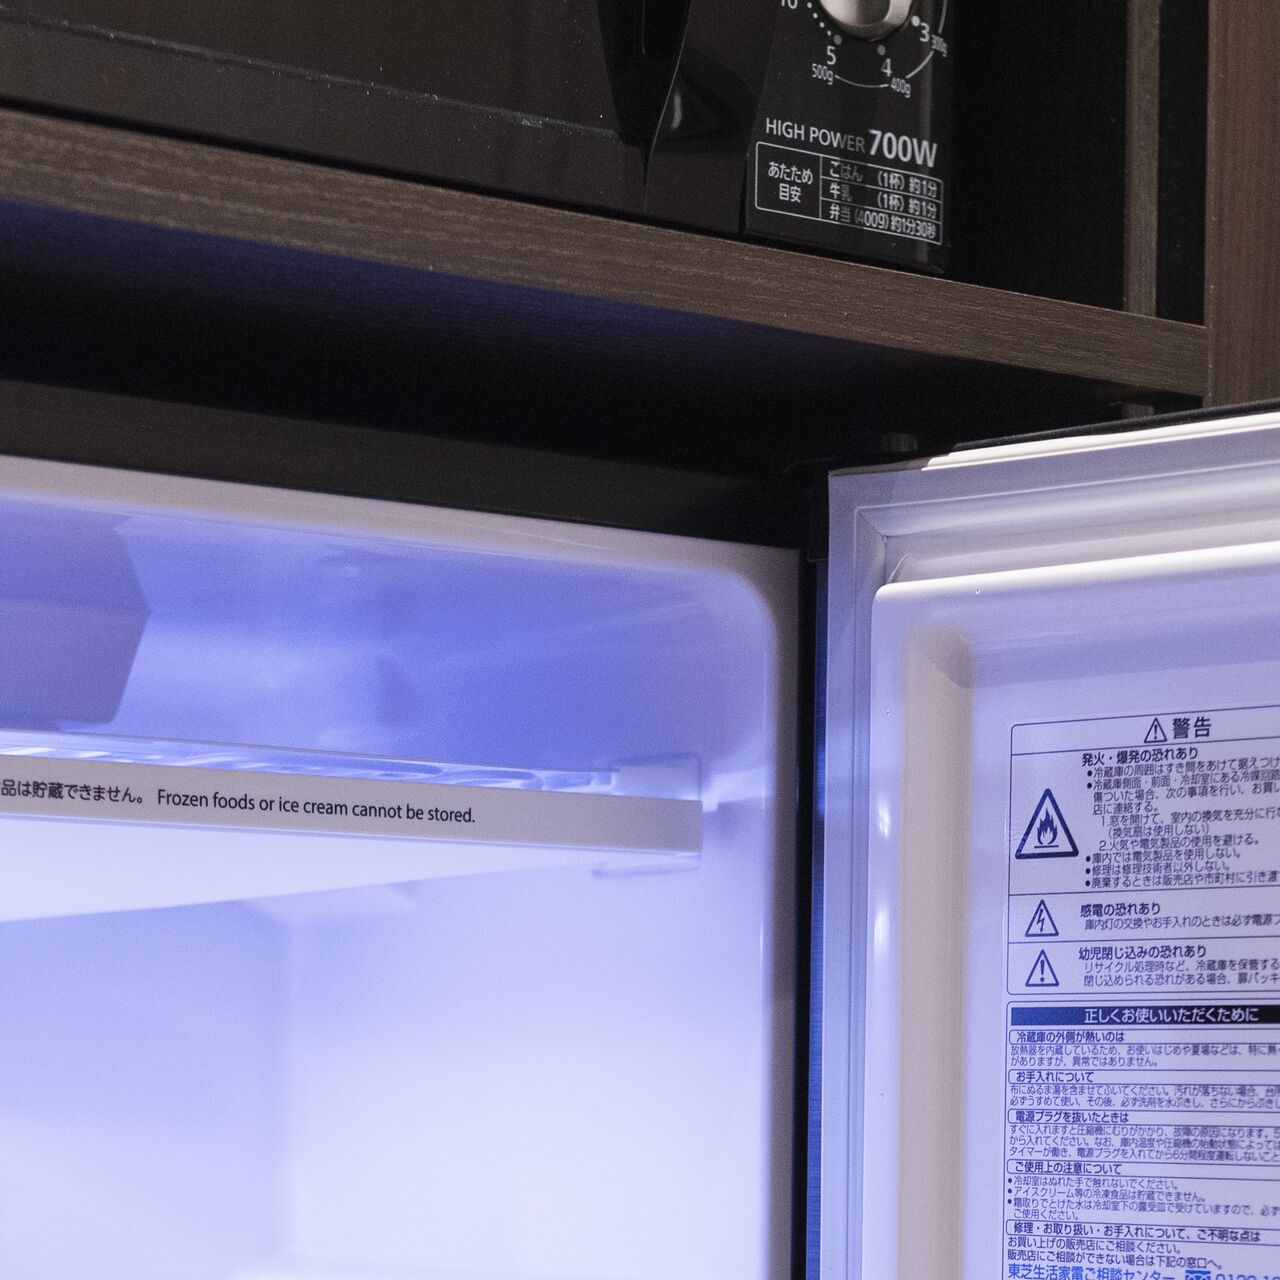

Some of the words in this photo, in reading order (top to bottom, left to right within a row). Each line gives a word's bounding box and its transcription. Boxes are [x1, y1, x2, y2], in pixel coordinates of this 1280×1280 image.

[920, 23, 930, 43] 3
[826, 46, 837, 65] 5
[811, 63, 834, 85] 500g
[880, 58, 892, 78] 4
[890, 77, 911, 98] 400g
[765, 117, 805, 141] HIGH
[809, 126, 865, 153] POWER
[868, 129, 938, 168] 700W
[768, 161, 814, 185] あたため
[829, 160, 863, 183] ごはん
[908, 176, 937, 199] 約1分
[778, 183, 802, 204] 目安
[829, 182, 853, 202] 牛乳
[908, 198, 937, 220] 約1分
[829, 203, 851, 224] 弁当
[1171, 716, 1213, 740] 警告
[1081, 747, 1199, 767] 発火・爆発の恐れあり
[157, 789, 209, 808] Frozen
[213, 792, 255, 811] foods
[259, 798, 275, 811] or
[278, 796, 300, 814] ice
[303, 799, 348, 816] cream
[352, 801, 403, 819] cannot
[406, 803, 424, 820] be
[427, 804, 476, 824] stored.
[1093, 803, 1158, 815] 店に連絡する。
[1091, 847, 1241, 865] 庫内では電気製品を使用しない。
[1080, 902, 1161, 918] 感電の恐れあり
[1078, 944, 1207, 961] 幼児閉じ込みの恐れあり
[1084, 1008, 1260, 1024] 正しくお使いいただくために
[1016, 1031, 1125, 1044] 冷蔵庫の外側が熱いのは
[1016, 1071, 1095, 1084] お手入れについて
[1015, 1111, 1129, 1124] 電源プラグを抜いたときは
[1015, 1161, 1122, 1175] ご使用上の注意について
[1014, 1208, 1079, 1220] ご使用ください。
[1007, 1236, 1181, 1254] お買い上げの販売店にご相談ください。
[1007, 1249, 1223, 1270] 販売店にご相談ができない場合は下記の窓口へ。
